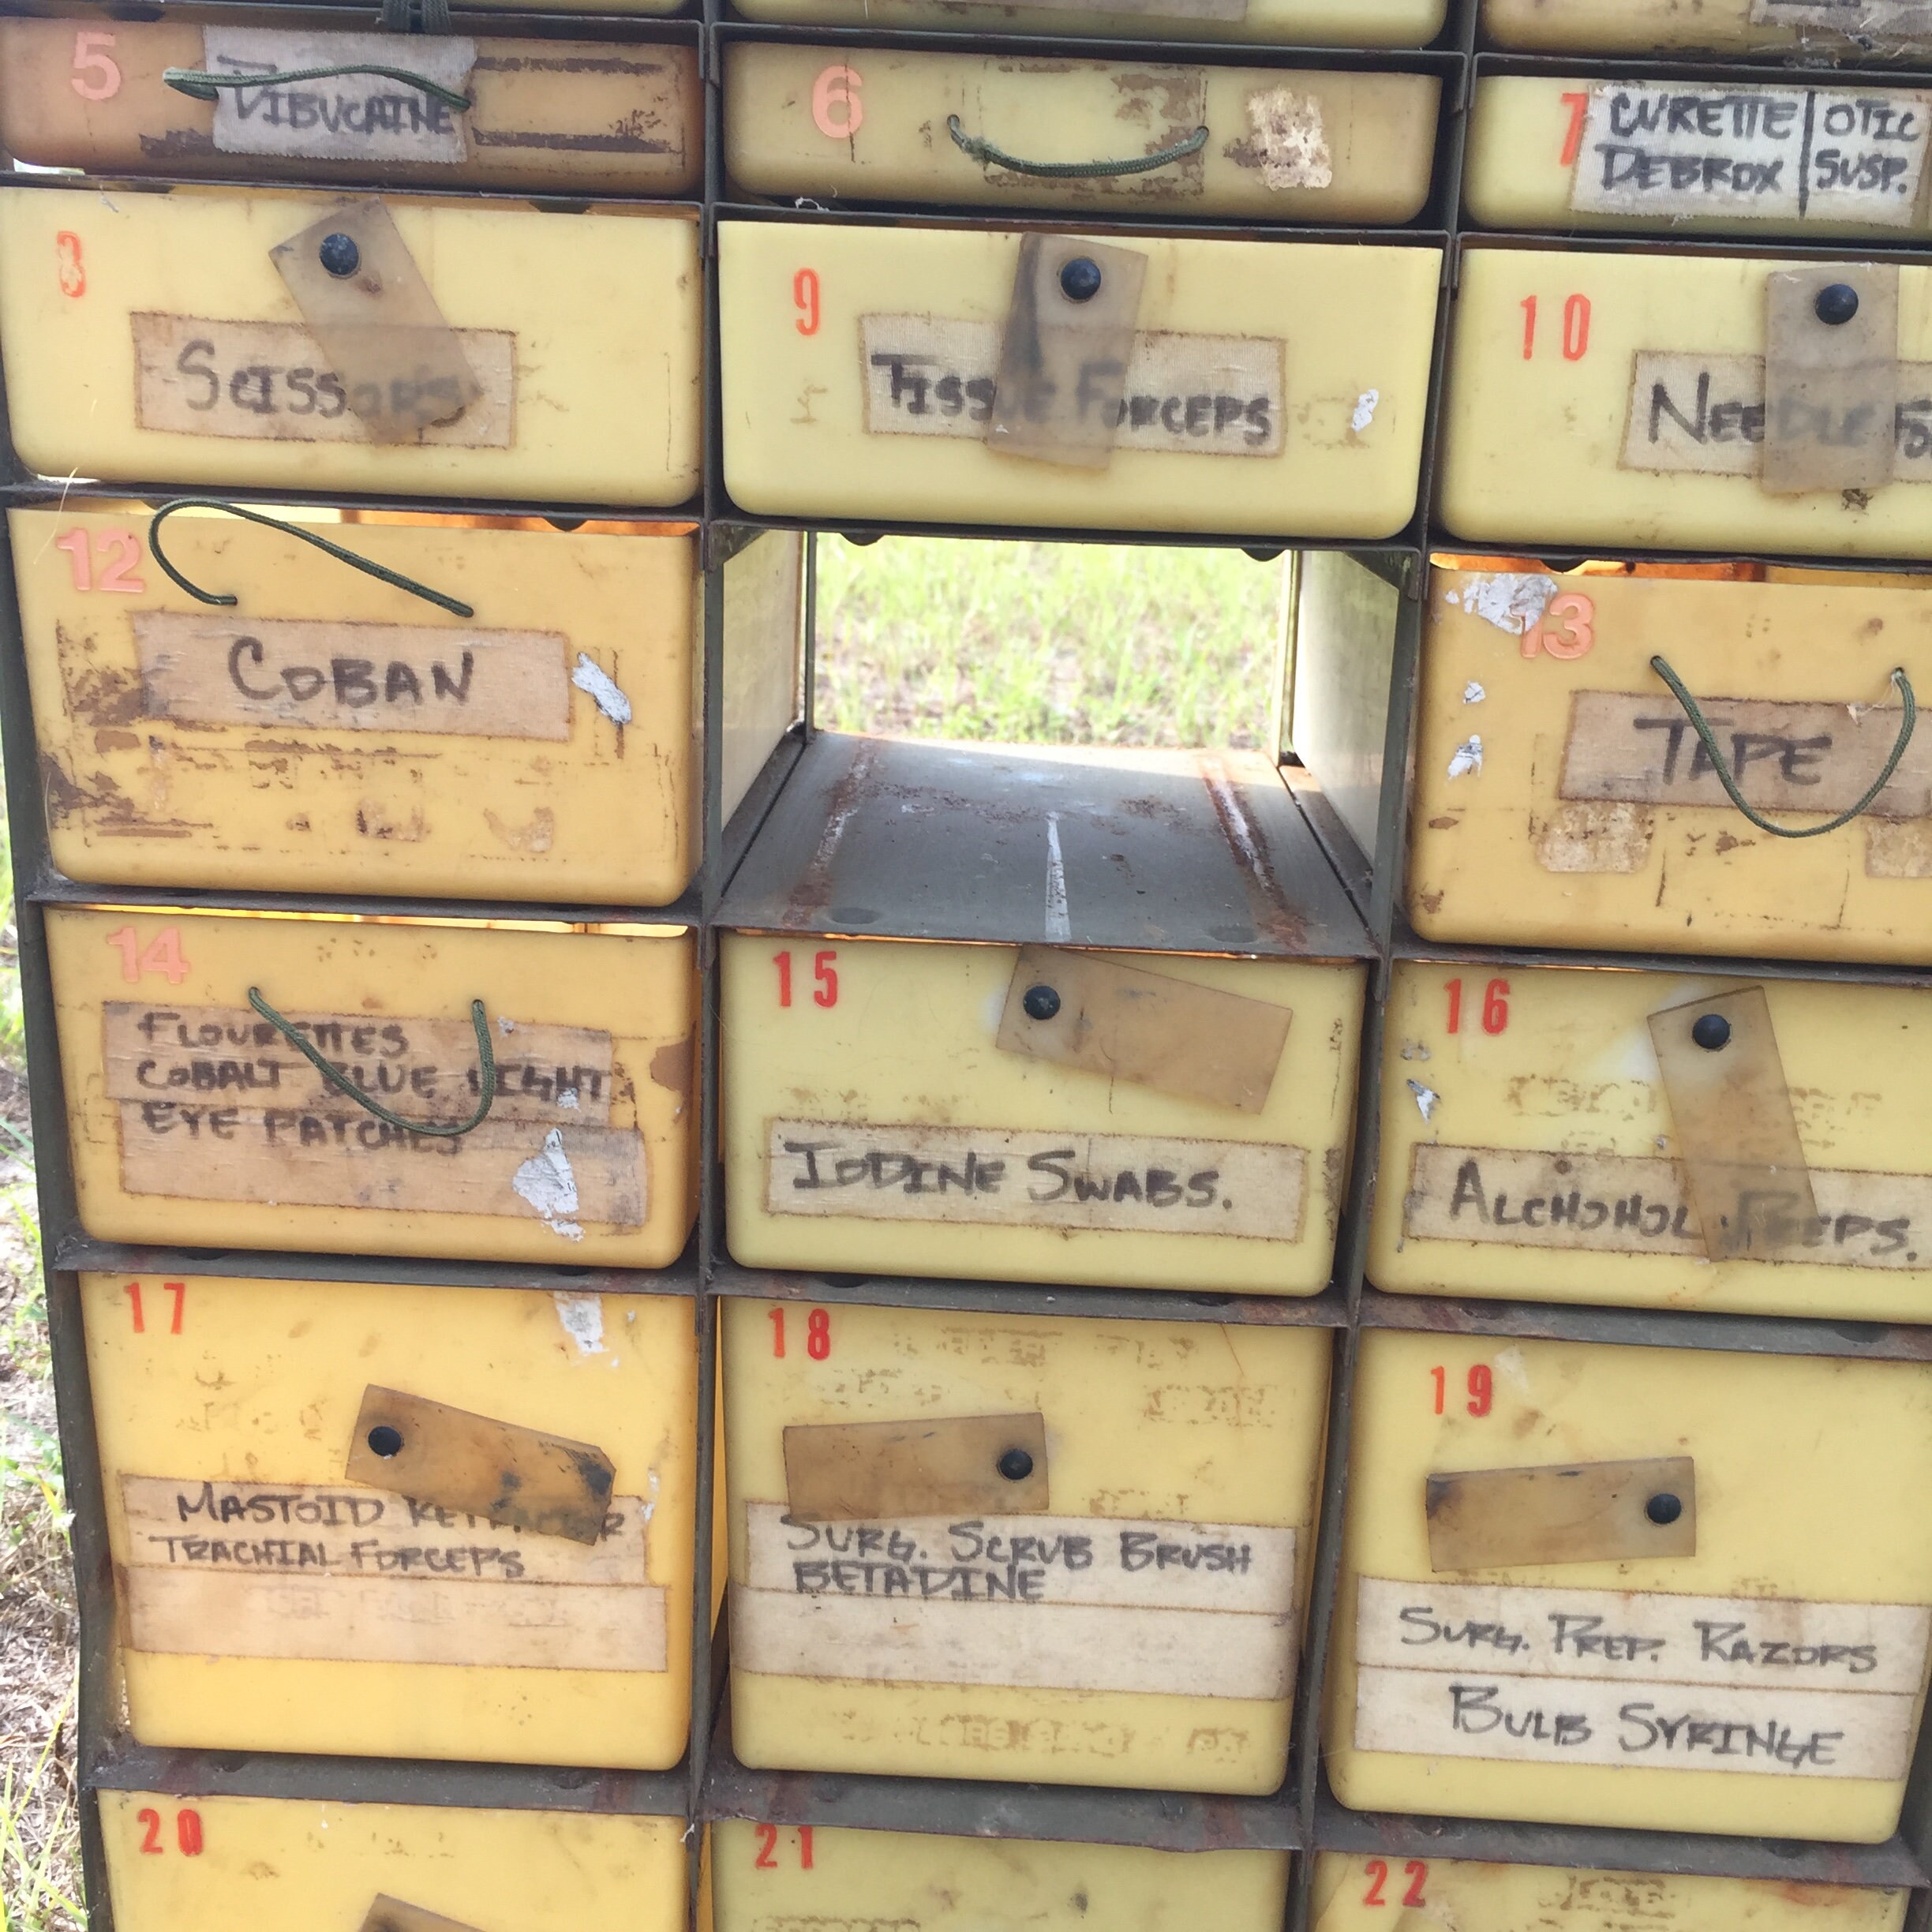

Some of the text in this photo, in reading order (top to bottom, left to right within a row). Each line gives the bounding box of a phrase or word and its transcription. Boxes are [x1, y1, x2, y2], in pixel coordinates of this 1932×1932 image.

[66, 28, 125, 105] 5
[811, 62, 865, 140] 6
[1559, 92, 1589, 167] 7
[1610, 92, 1921, 141] CURETTE OTIC
[1595, 144, 1908, 194] DEBROX SUSP.
[56, 230, 87, 298] 8
[793, 268, 820, 336] 9
[1520, 293, 1592, 361] 10
[56, 527, 146, 594] 12
[1518, 592, 1596, 660] 13
[227, 635, 474, 707] COBAN
[1633, 717, 1833, 786] TAPE
[107, 927, 190, 985] 14
[771, 950, 839, 1009] 15
[1443, 978, 1511, 1035] 16
[136, 1058, 281, 1091] COBALT
[321, 1060, 439, 1099] BLUE
[140, 1099, 466, 1157] EYE PATCHES
[784, 1141, 1005, 1195] IODINE
[125, 1282, 186, 1335] 17
[768, 1307, 831, 1361] 18
[1430, 1364, 1493, 1417] 19
[175, 1481, 386, 1527] MASTOID
[350, 1540, 527, 1578] FORCEPS
[780, 1513, 1252, 1574] SURG. SCRUB BRUSH
[792, 1560, 1048, 1602] BETADINE
[1399, 1605, 1531, 1654] SURG.
[1692, 1619, 1879, 1674] RAZORS
[1447, 1684, 1845, 1769] BULB SYRINGE
[137, 1807, 204, 1857] 20
[754, 1822, 814, 1870] 21
[1363, 1859, 1429, 1908] 22
